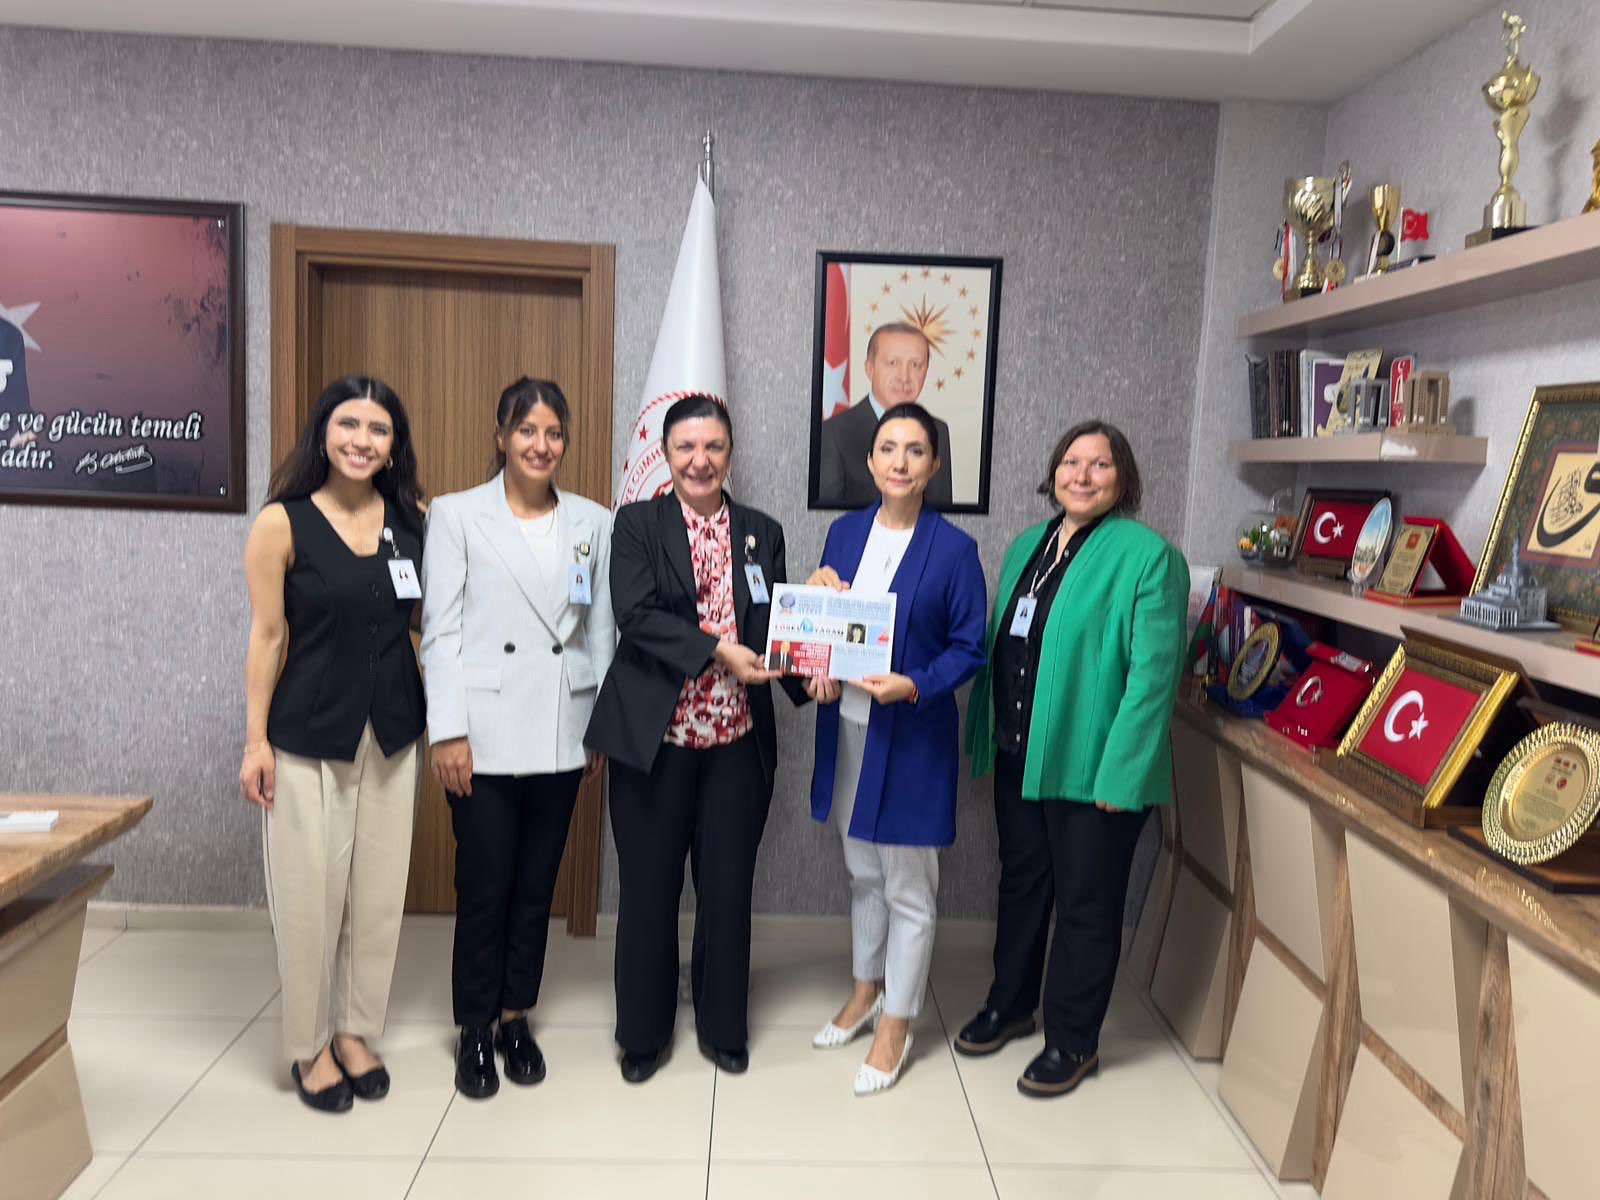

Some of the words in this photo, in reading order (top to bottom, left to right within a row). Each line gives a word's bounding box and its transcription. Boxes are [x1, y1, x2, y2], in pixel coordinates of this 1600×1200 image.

[17, 413, 45, 433] ve
[49, 410, 123, 442] gücün
[131, 412, 202, 440] temeli
[0, 439, 53, 470] adır.
